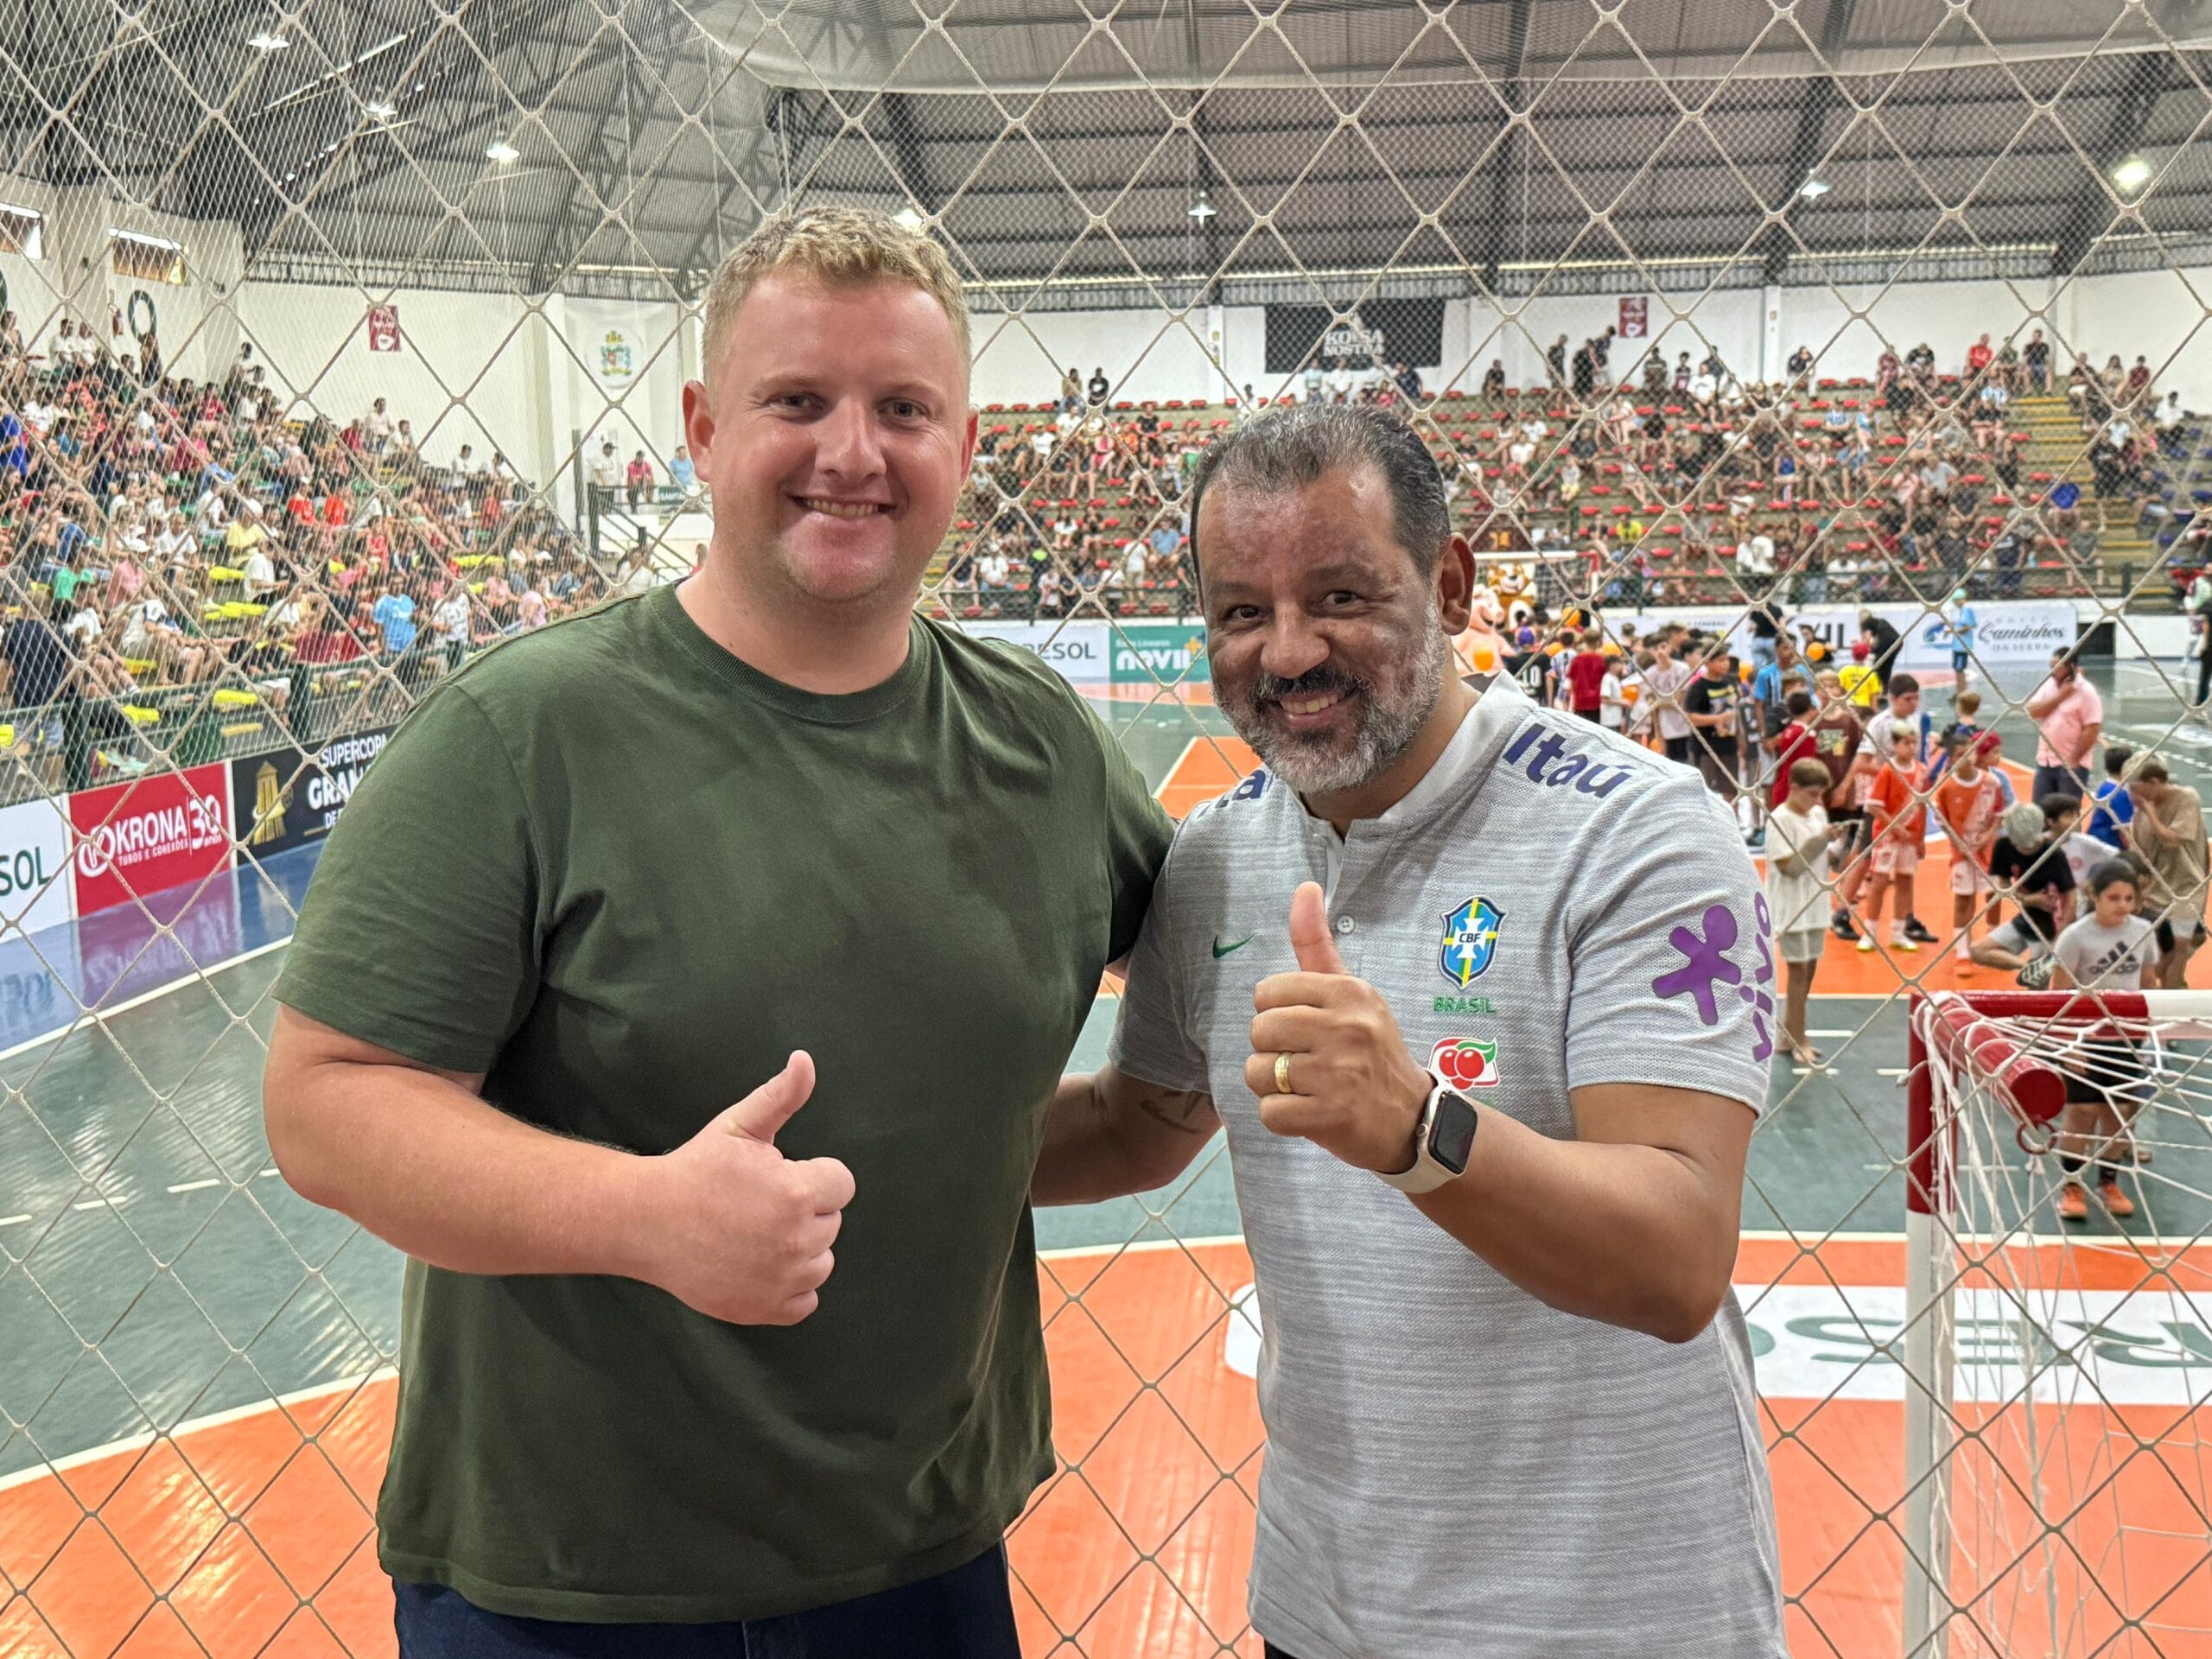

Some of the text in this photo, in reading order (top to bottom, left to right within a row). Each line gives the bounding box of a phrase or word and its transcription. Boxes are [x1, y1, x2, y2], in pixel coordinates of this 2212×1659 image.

[1978, 621, 2064, 645] Caminhos
[1023, 642, 1097, 660] ESOL
[1503, 722, 1637, 799] Itaú
[115, 794, 222, 855] KRONA 30
[118, 849, 143, 866] TUBOS
[1459, 932, 1482, 944] CBF
[1738, 891, 1774, 1063] vivo
[1433, 996, 1496, 1014] BRASIL
